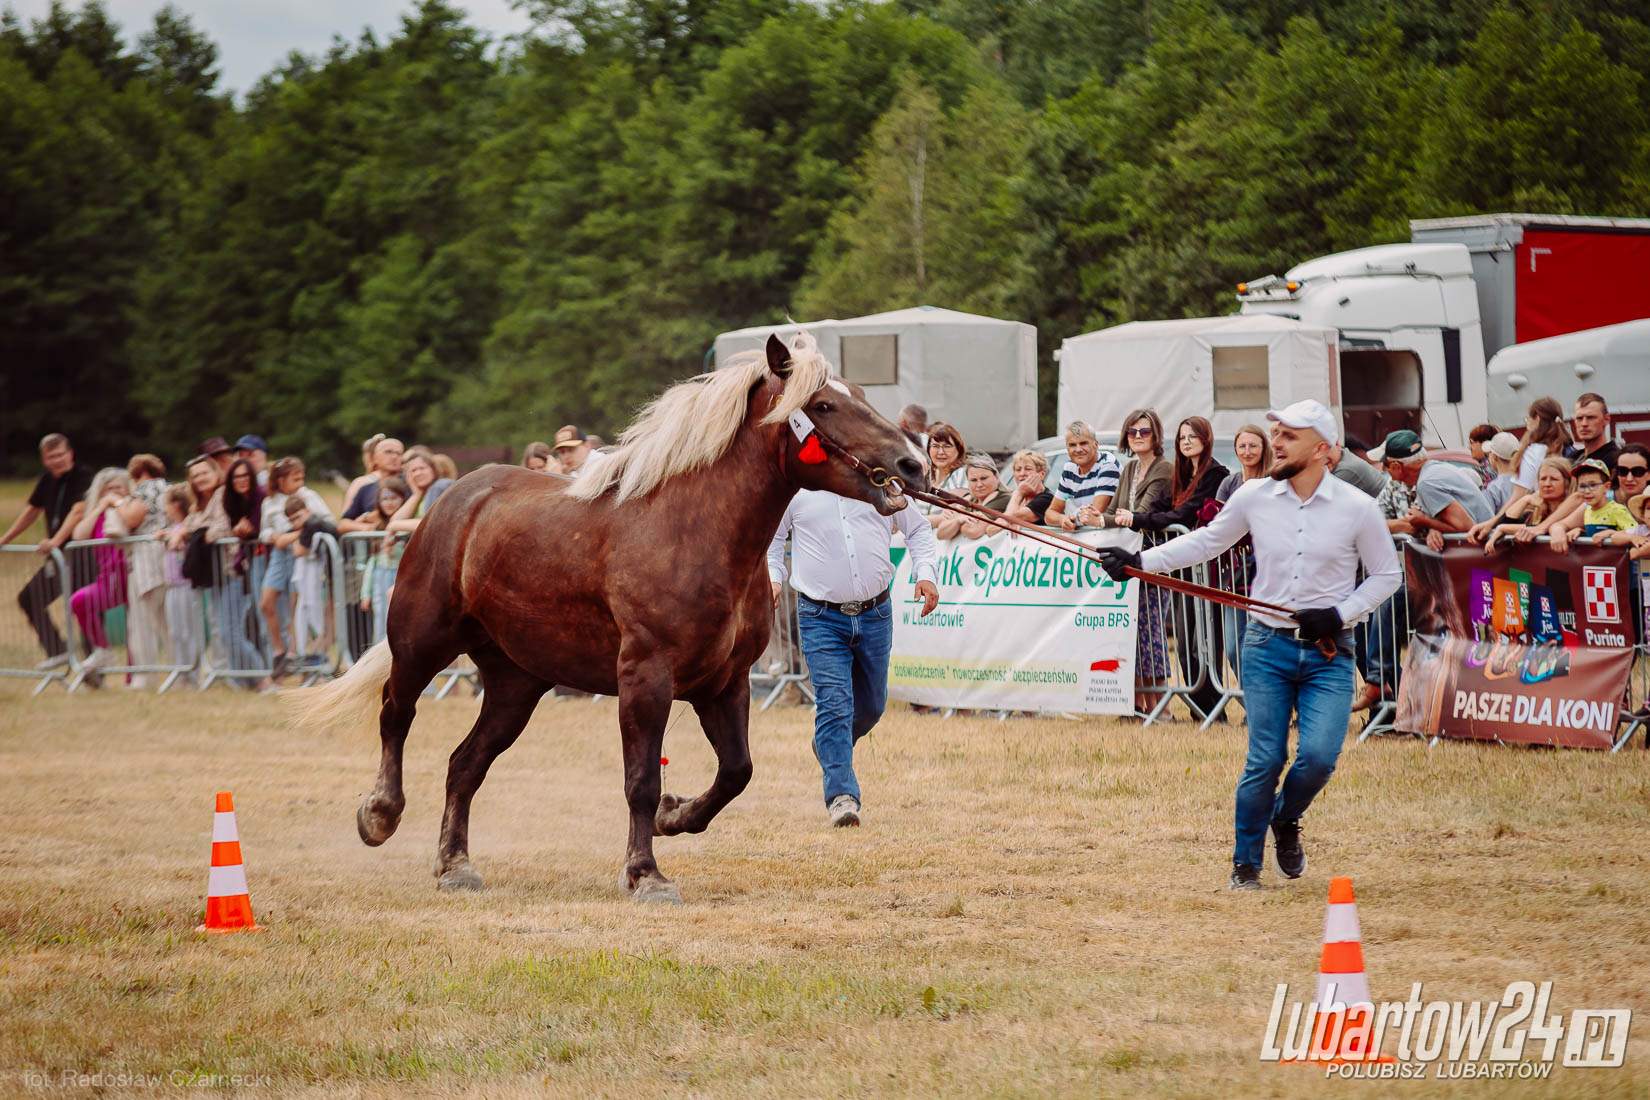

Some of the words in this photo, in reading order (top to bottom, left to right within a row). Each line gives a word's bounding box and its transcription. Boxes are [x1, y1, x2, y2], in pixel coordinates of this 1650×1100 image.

[908, 545, 964, 586] nk
[1075, 612, 1105, 631] Grupa
[1108, 612, 1130, 628] BPS
[1585, 628, 1625, 647] Purina
[1453, 690, 1513, 722] PASZE
[1514, 695, 1552, 726] DLA
[1555, 699, 1614, 731] KONI
